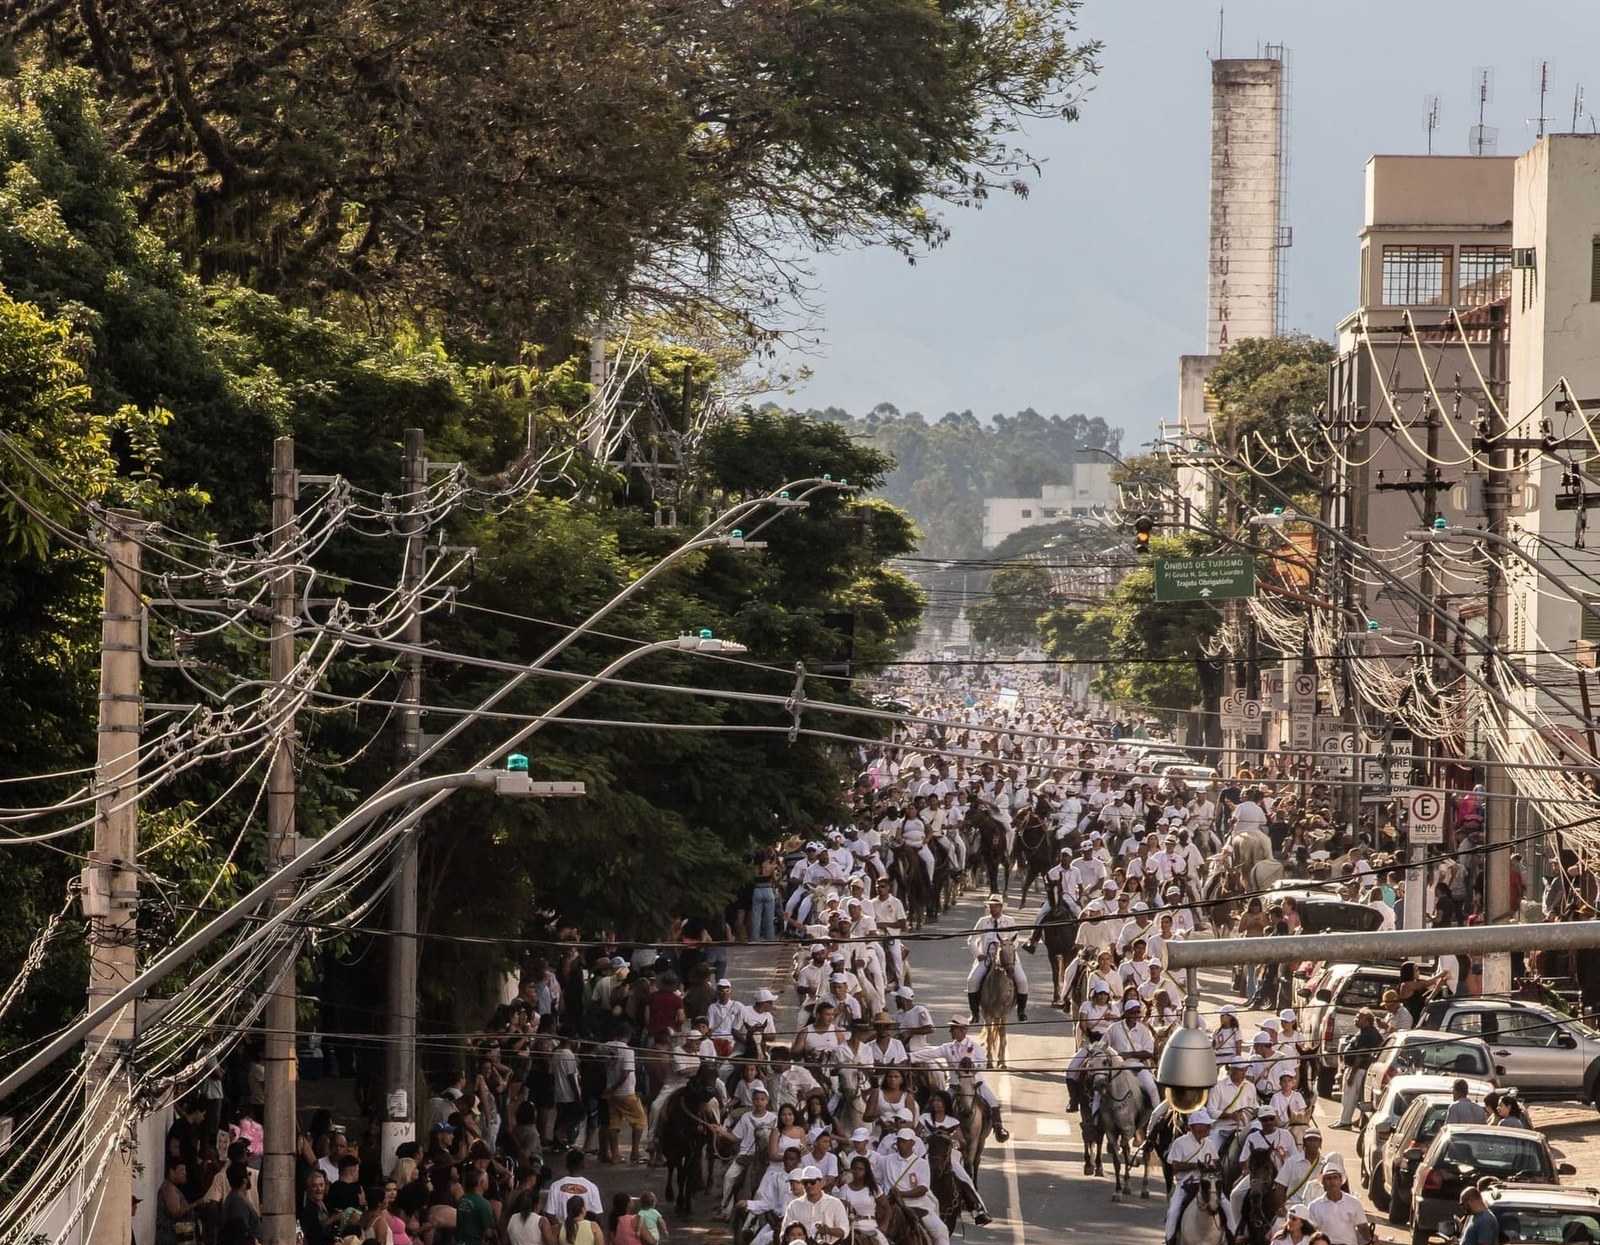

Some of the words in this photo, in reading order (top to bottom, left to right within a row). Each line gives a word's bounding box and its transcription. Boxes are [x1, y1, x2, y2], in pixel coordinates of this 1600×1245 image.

[1164, 561, 1193, 570] ÔNIBUS
[1195, 561, 1206, 569] DE
[1208, 559, 1243, 568] TURISMO
[1177, 580, 1197, 588] Trajeto
[1199, 578, 1233, 586] Obrigatório
[1248, 704, 1255, 716] E
[1328, 742, 1338, 750] 30
[1421, 798, 1431, 816] E
[1415, 824, 1437, 833] MOTO
